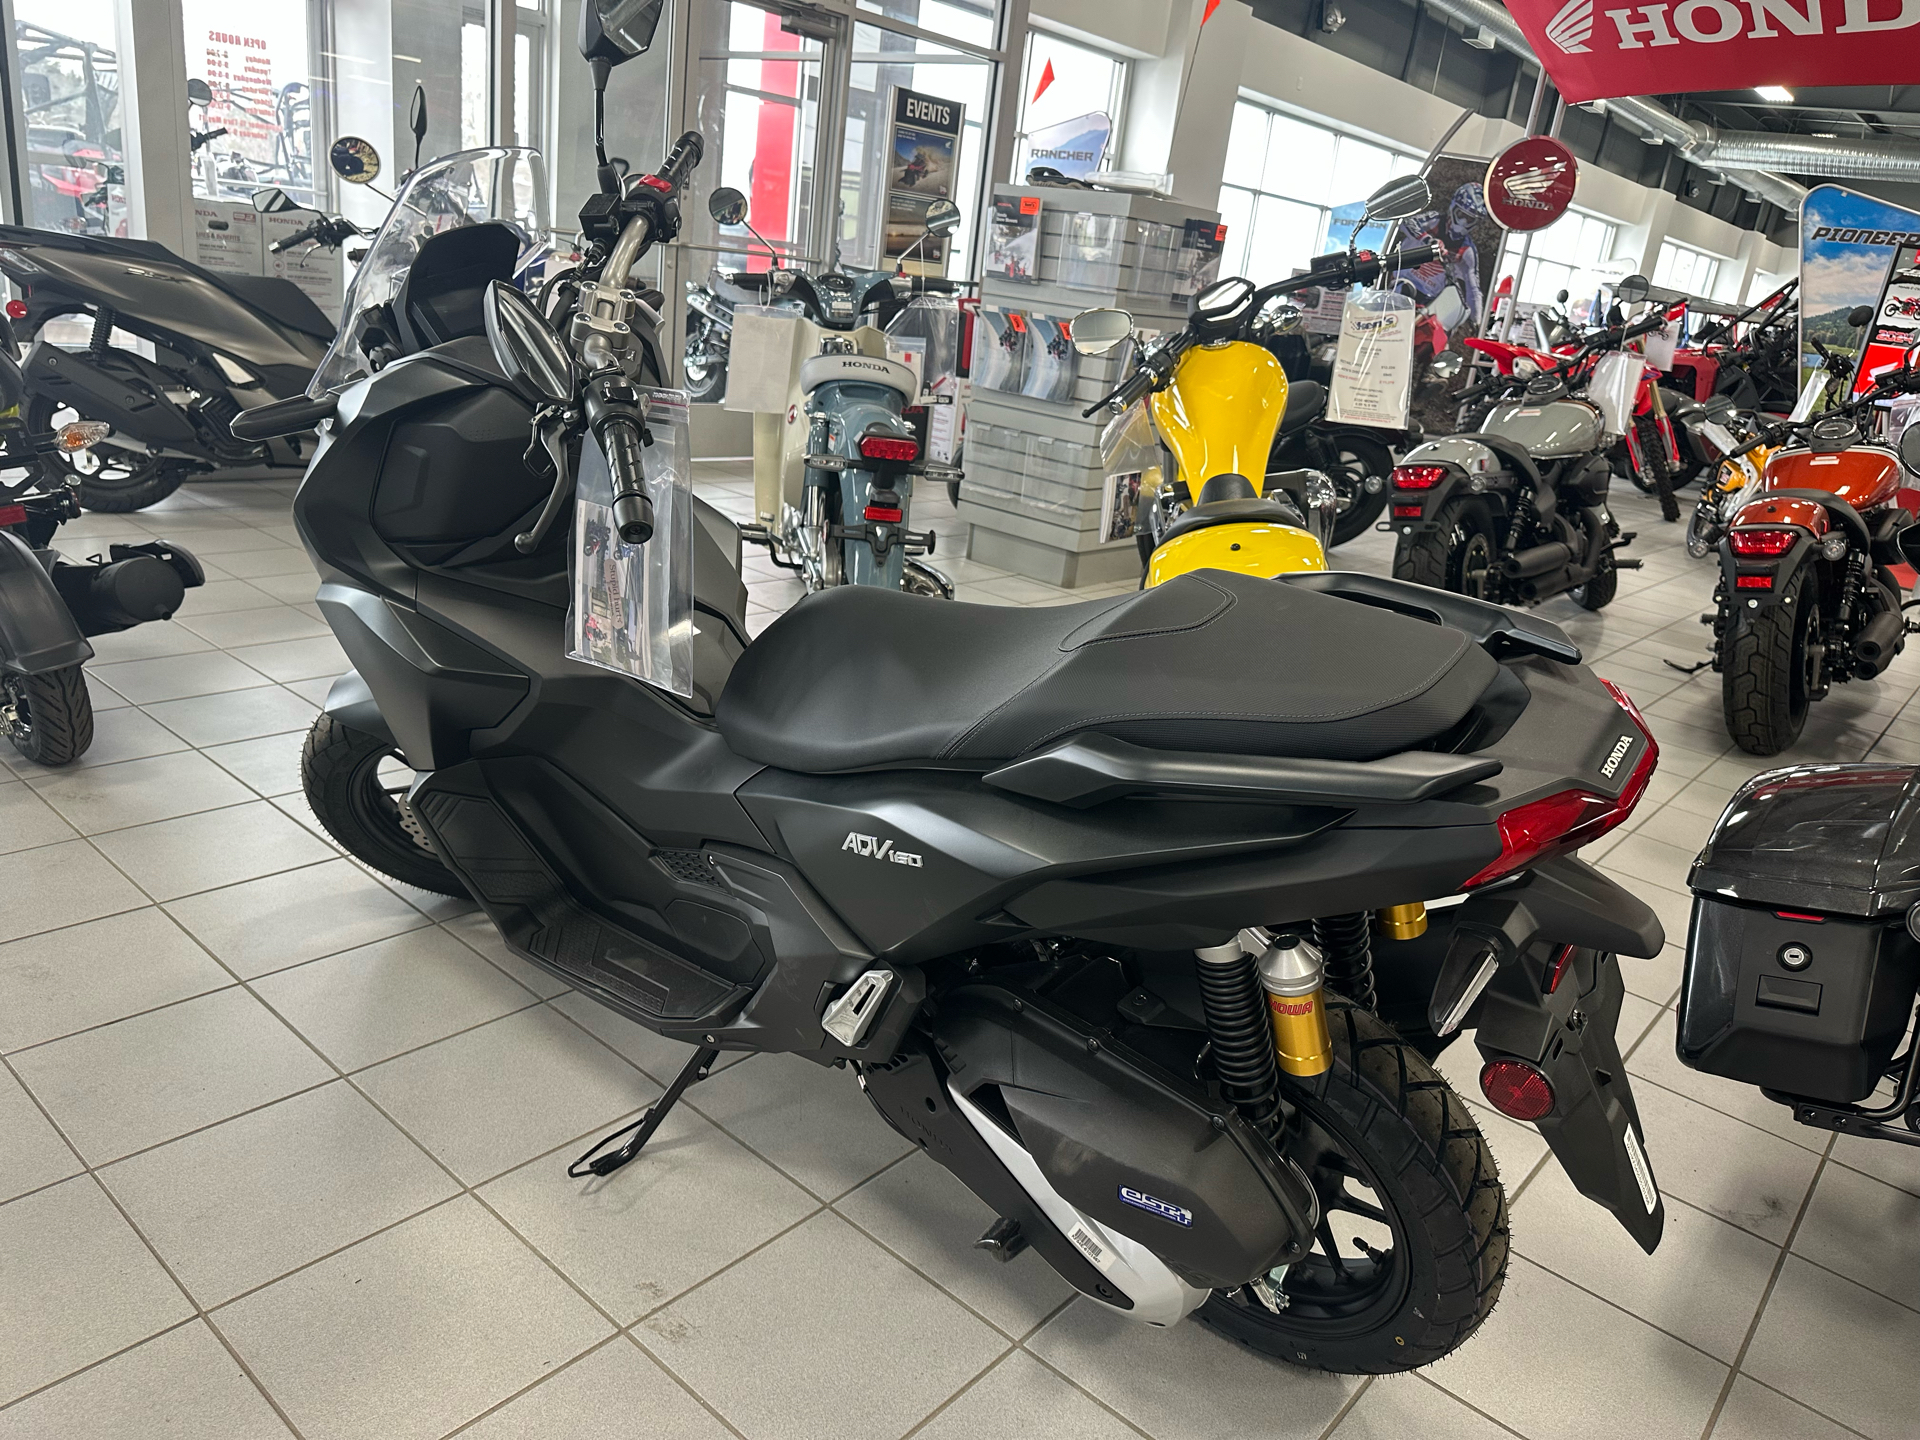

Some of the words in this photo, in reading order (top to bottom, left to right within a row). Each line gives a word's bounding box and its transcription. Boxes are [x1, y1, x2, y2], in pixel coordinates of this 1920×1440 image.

[906, 98, 950, 125] EVENTS
[1031, 148, 1094, 162] RANCHER
[1502, 196, 1554, 211] HONDA
[268, 216, 304, 226] HONDA
[1876, 329, 1914, 344] 2024
[841, 361, 891, 374] HONDA
[1600, 735, 1634, 779] HONDA
[1269, 998, 1313, 1015] HOWA
